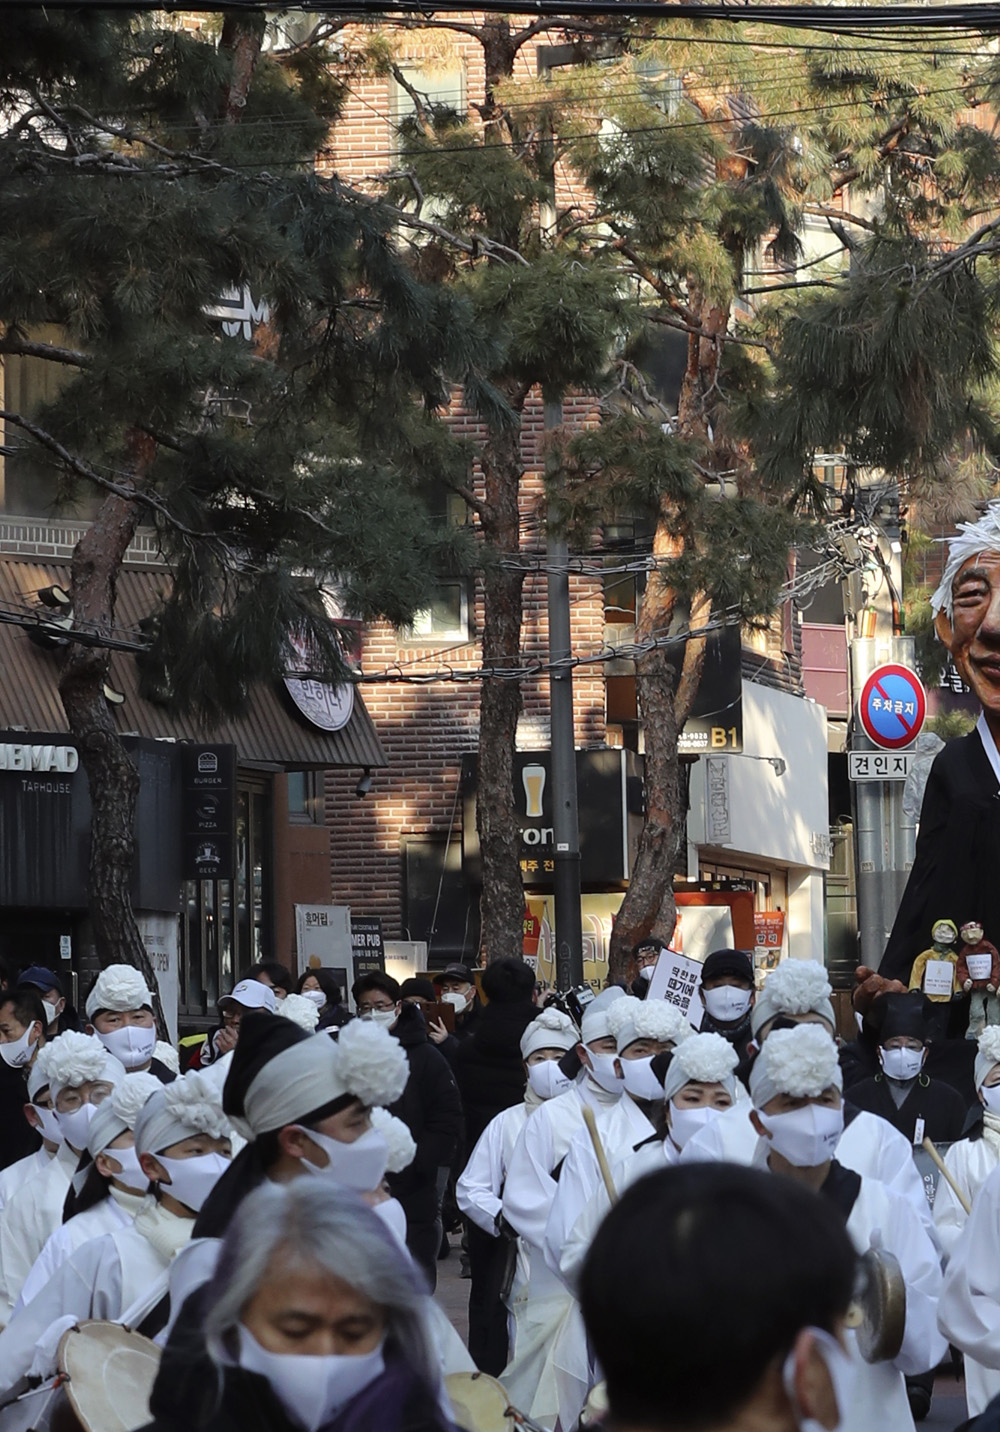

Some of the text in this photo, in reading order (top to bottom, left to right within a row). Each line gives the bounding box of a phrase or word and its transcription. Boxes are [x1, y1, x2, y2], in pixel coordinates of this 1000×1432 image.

[872, 697, 915, 716] 주차금지
[711, 727, 737, 748] B1
[855, 756, 907, 775] 견인지
[21, 779, 71, 794] TAPHOUSE
[519, 827, 555, 845] on
[366, 934, 381, 947] PUB
